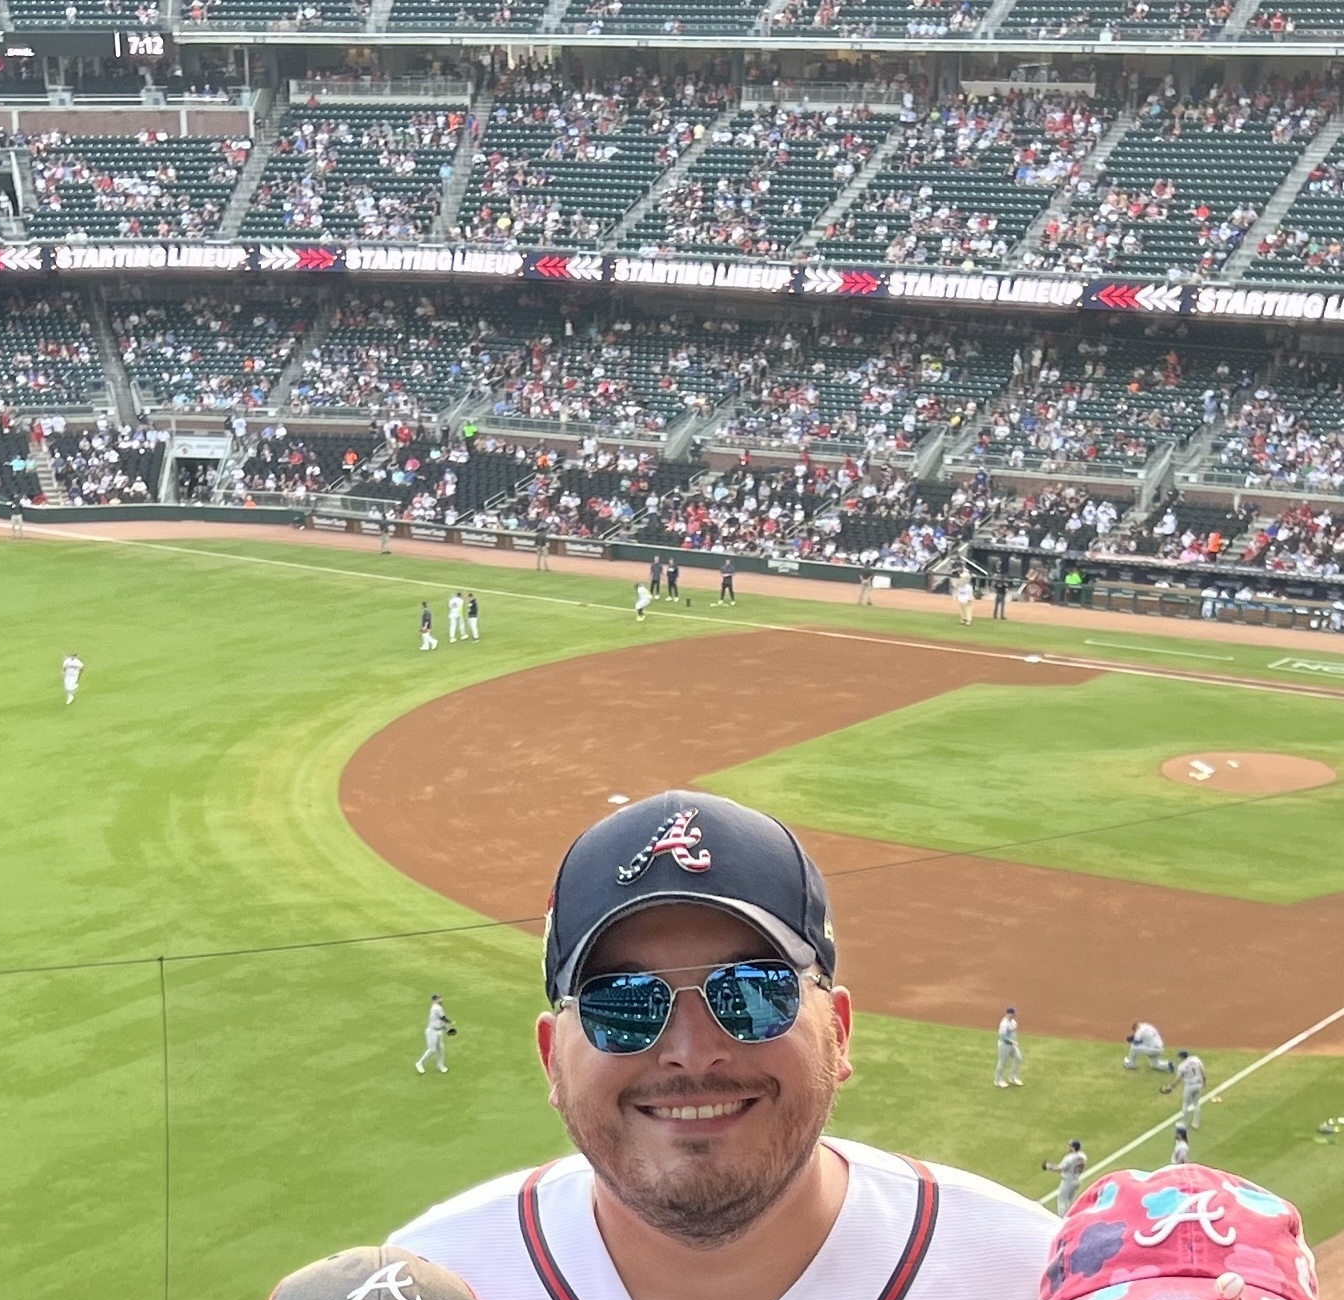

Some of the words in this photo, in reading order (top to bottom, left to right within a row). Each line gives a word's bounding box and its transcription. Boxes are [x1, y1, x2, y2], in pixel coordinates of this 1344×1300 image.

[128, 36, 164, 55] 7:12
[56, 248, 167, 269] STARTING
[168, 248, 247, 268] LINEUP
[346, 248, 453, 272] STARTING
[453, 250, 523, 274] LINEUP
[615, 256, 716, 286] STARTING
[716, 262, 792, 290] LINEUP
[889, 273, 996, 303] STARTING
[998, 275, 1082, 306] LINEUP
[1197, 287, 1317, 317] STARTING
[616, 808, 712, 886] A
[1134, 1189, 1237, 1247] A
